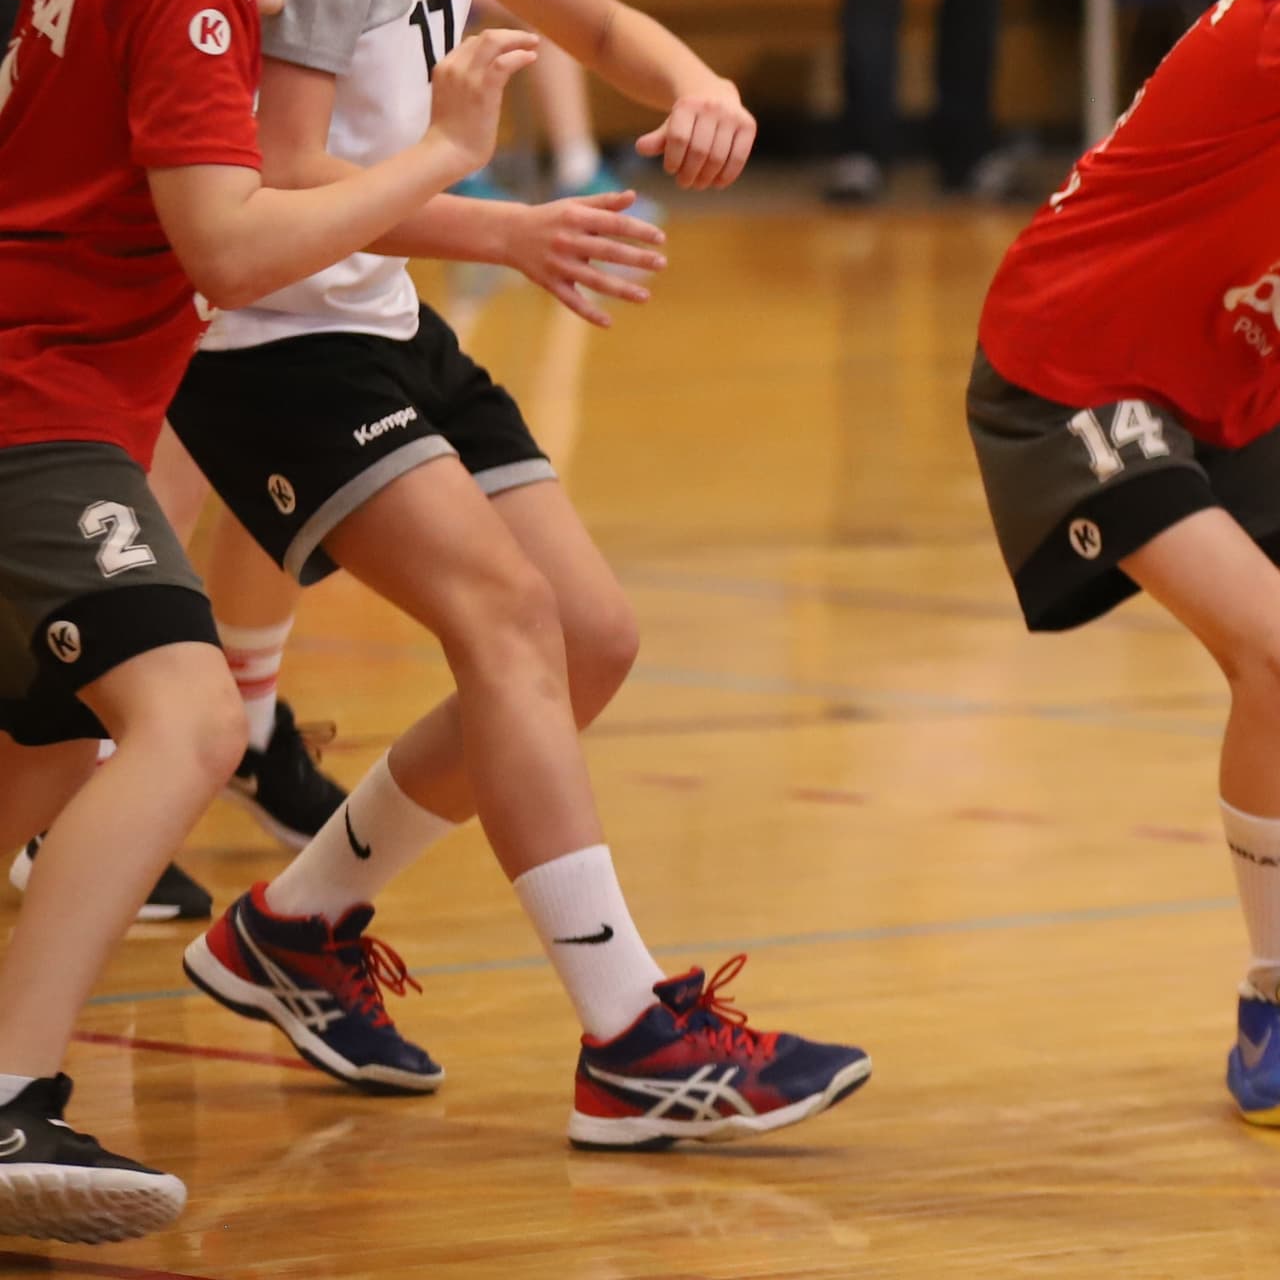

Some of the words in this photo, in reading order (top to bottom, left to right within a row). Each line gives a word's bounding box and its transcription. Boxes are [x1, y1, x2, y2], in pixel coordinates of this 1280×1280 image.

[353, 406, 418, 447] Kempa
[1066, 399, 1171, 483] 14
[77, 500, 157, 579] 2
